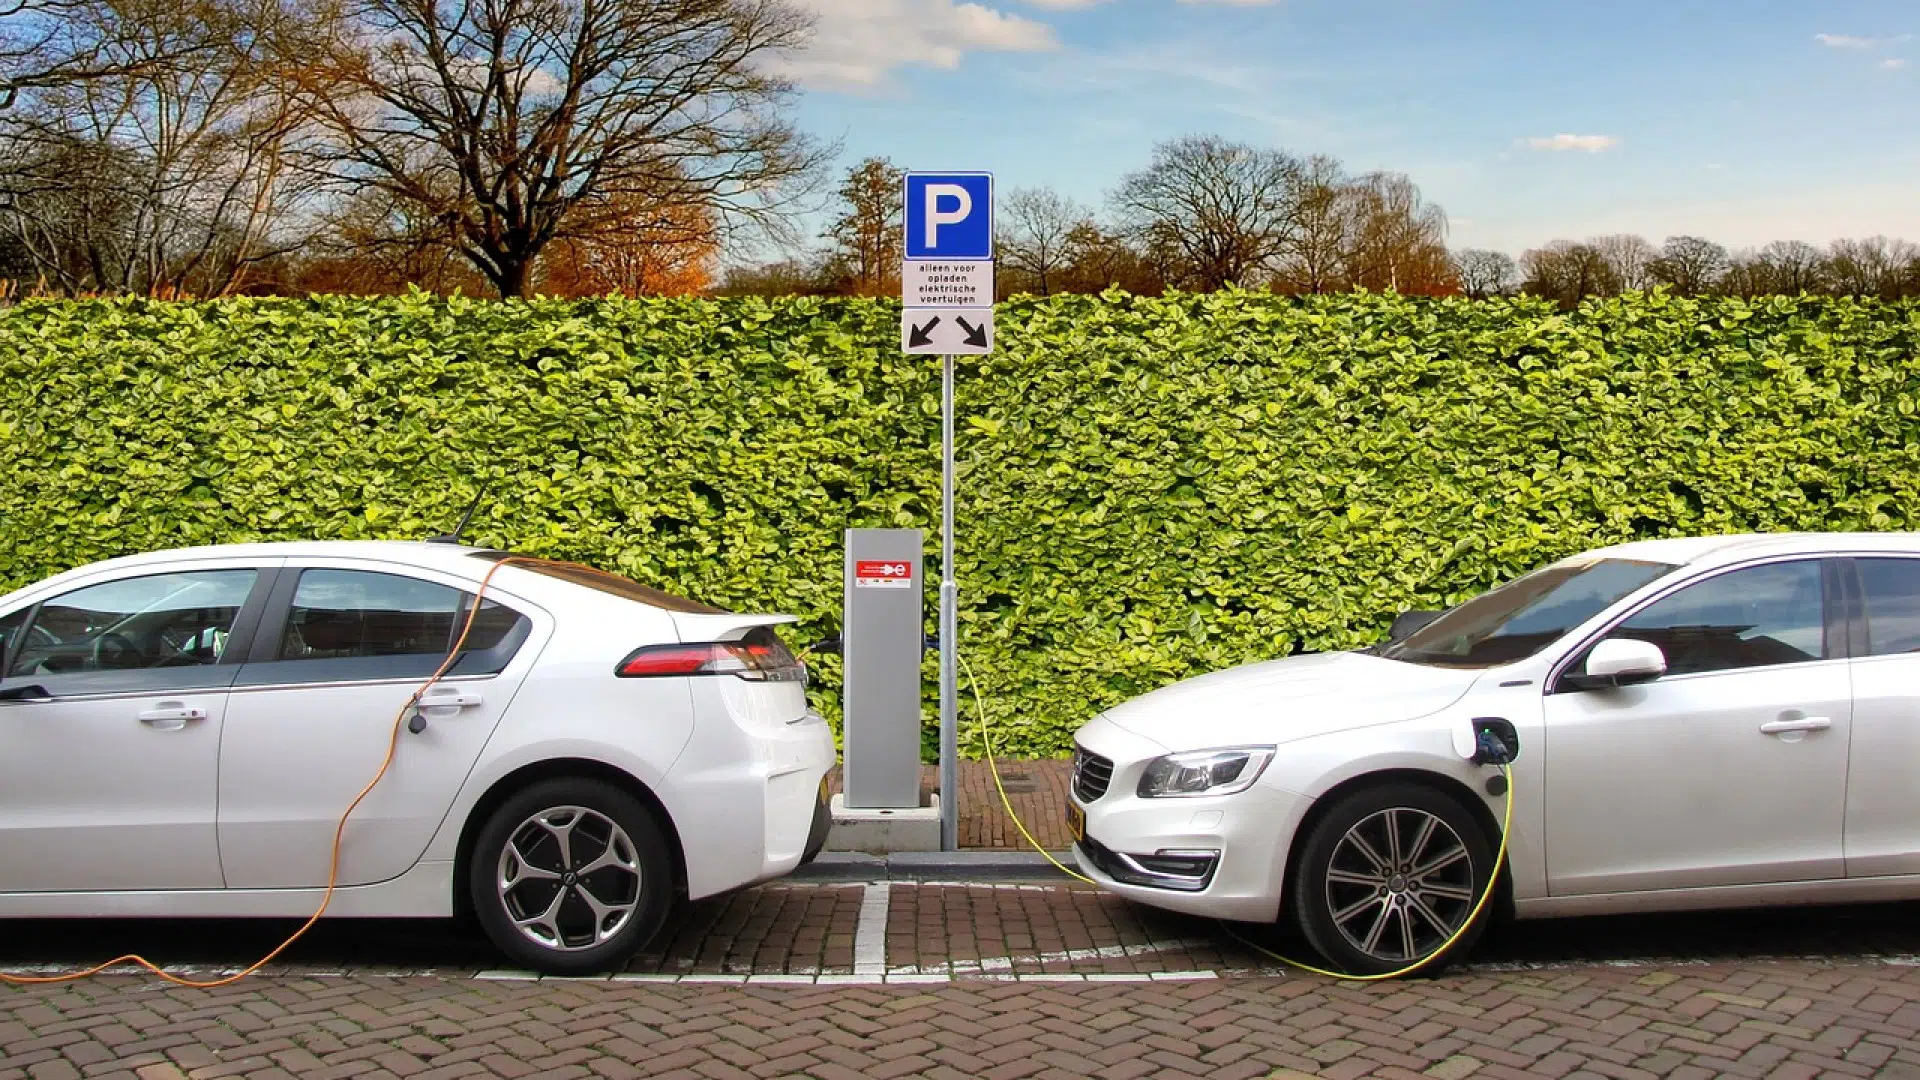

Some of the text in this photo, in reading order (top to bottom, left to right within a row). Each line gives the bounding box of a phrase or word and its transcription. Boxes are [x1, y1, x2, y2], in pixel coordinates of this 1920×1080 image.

[925, 184, 972, 248] P
[919, 264, 976, 273] alleen voor
[928, 274, 967, 284] opladen
[919, 284, 976, 293] elektrische
[920, 295, 976, 305] voertuigen
